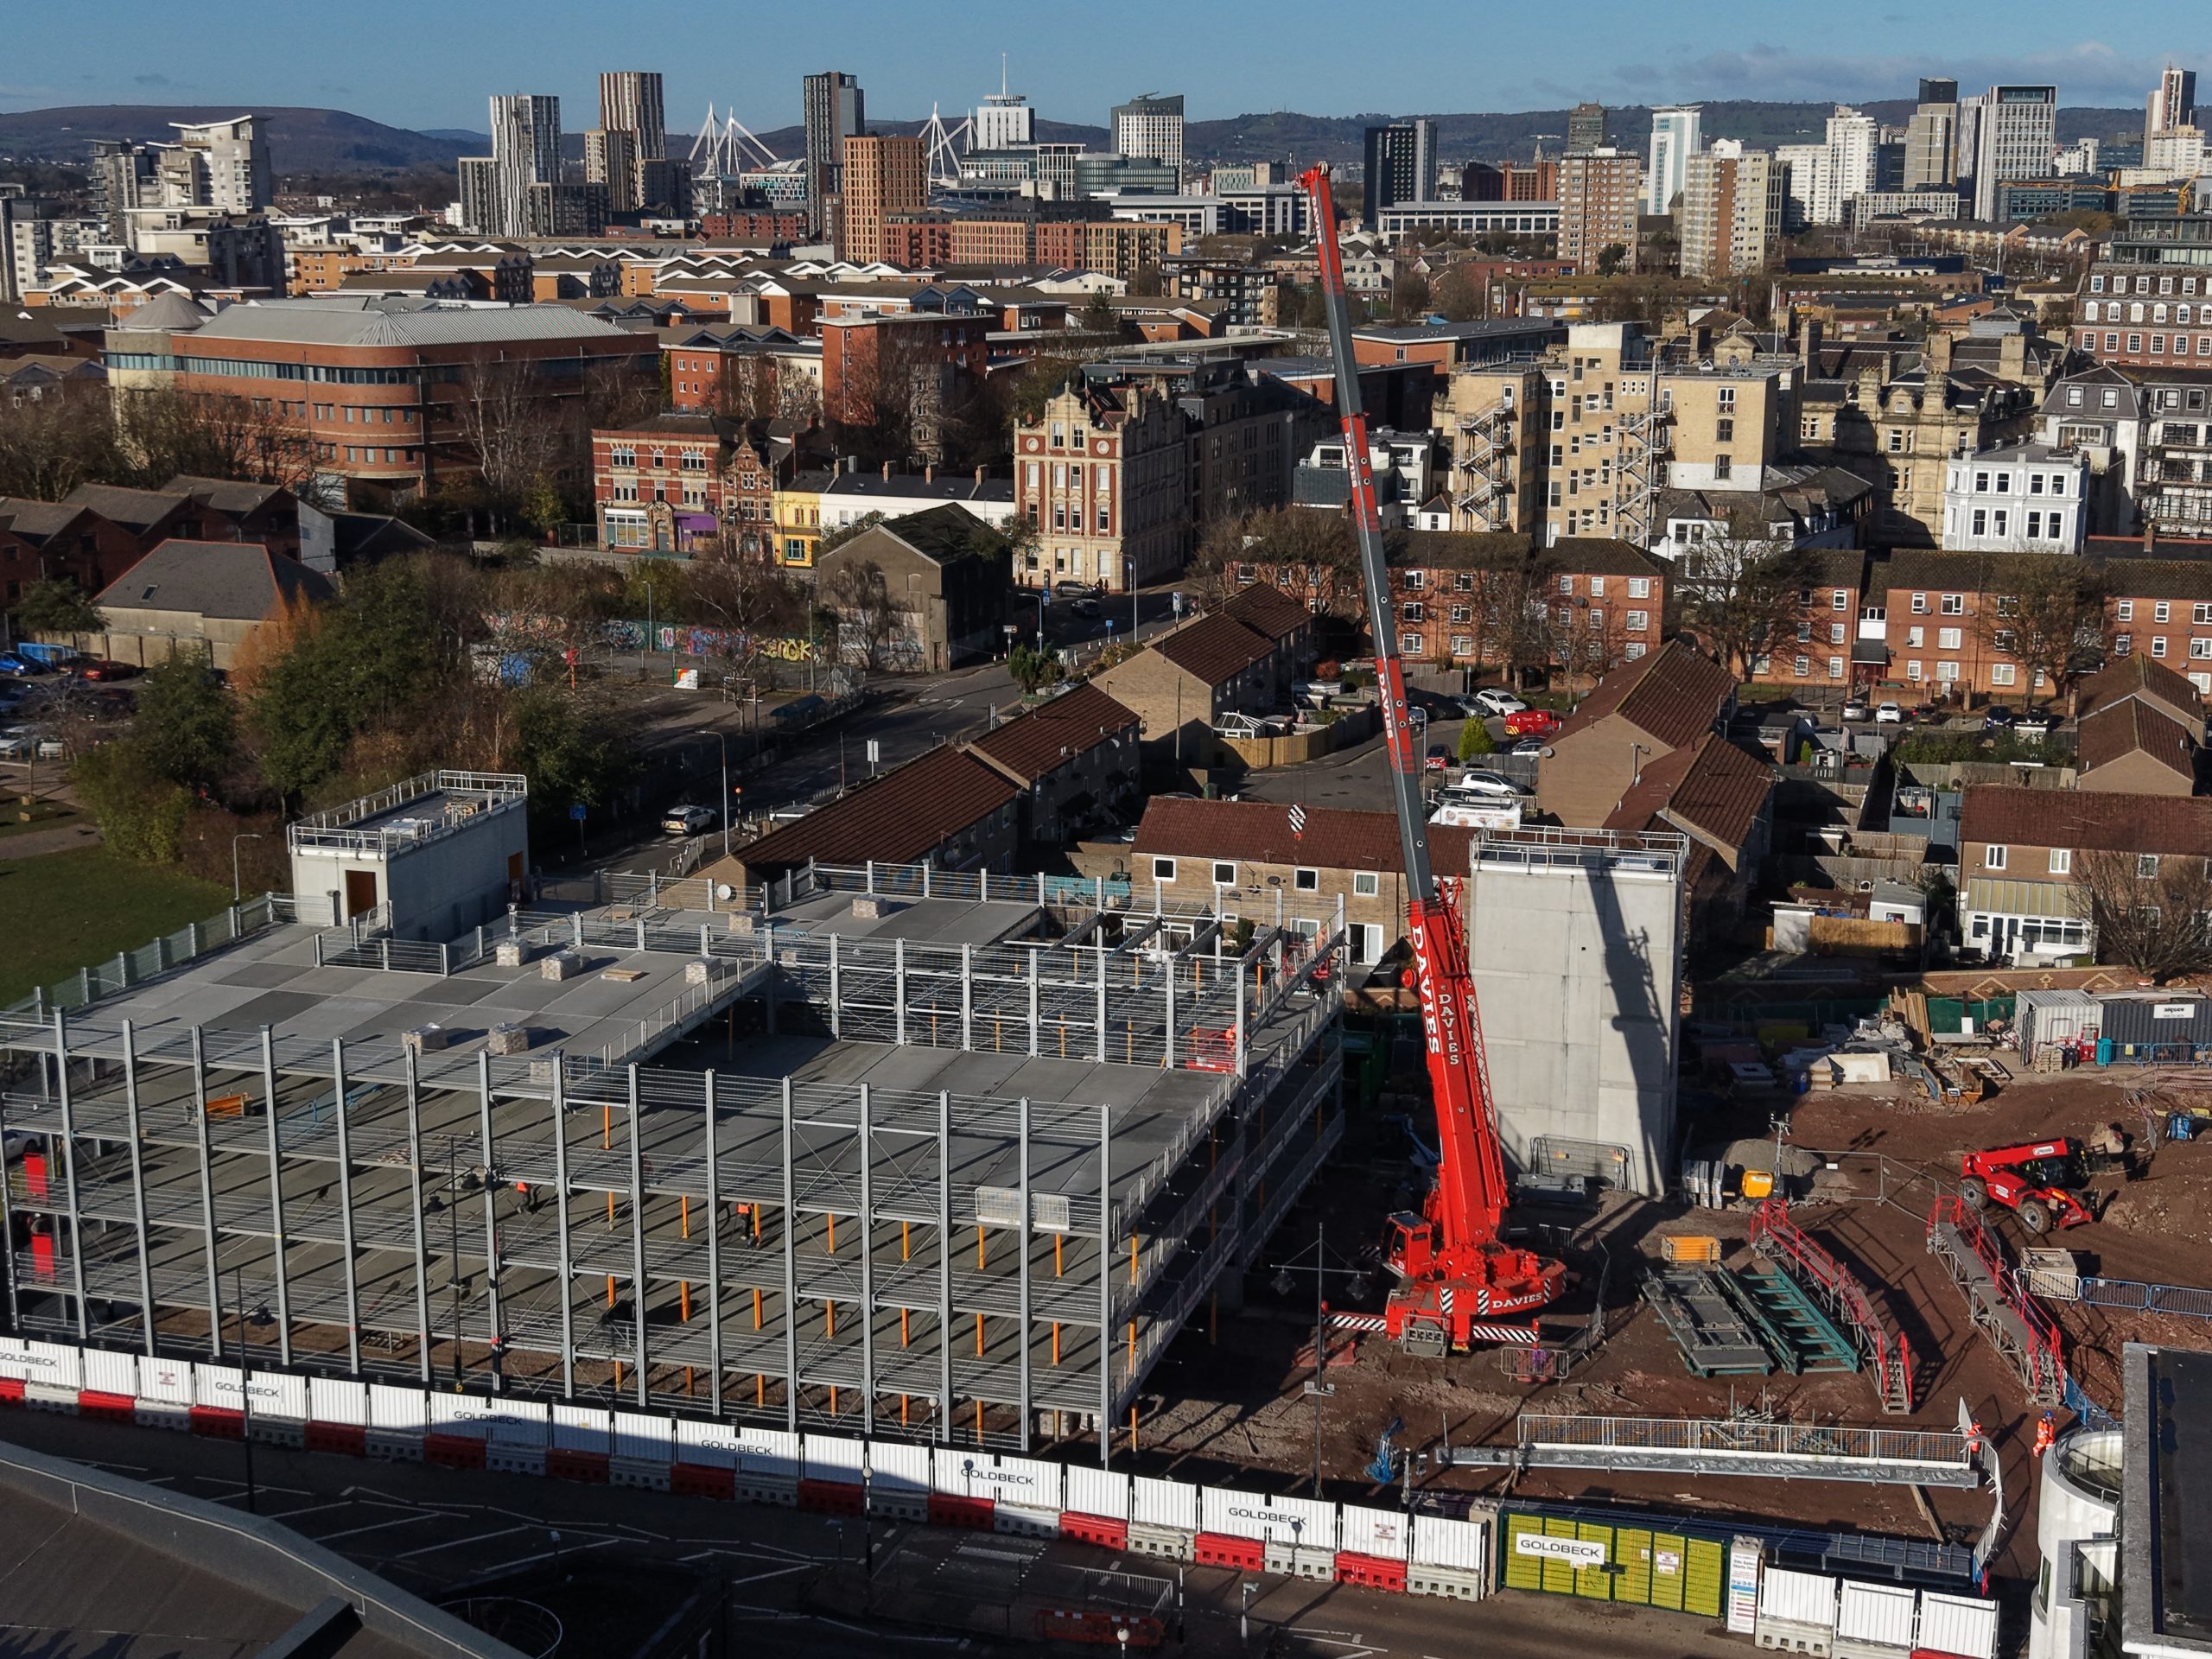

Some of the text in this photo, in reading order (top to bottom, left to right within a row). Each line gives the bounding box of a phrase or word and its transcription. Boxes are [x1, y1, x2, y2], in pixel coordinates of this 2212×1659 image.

[1344, 431, 1357, 488] DAVIES
[1378, 673, 1394, 739] DAVIES
[1412, 925, 1440, 1054] DAVIES
[1439, 994, 1459, 1065] DAVIES
[1492, 1294, 1542, 1309] DAVIES
[454, 1410, 523, 1426] GOLDBECK
[701, 1440, 772, 1456] GOLDBECK
[1228, 1507, 1306, 1526] GOLDBECK
[1521, 1540, 1600, 1559] GOLDBECK
